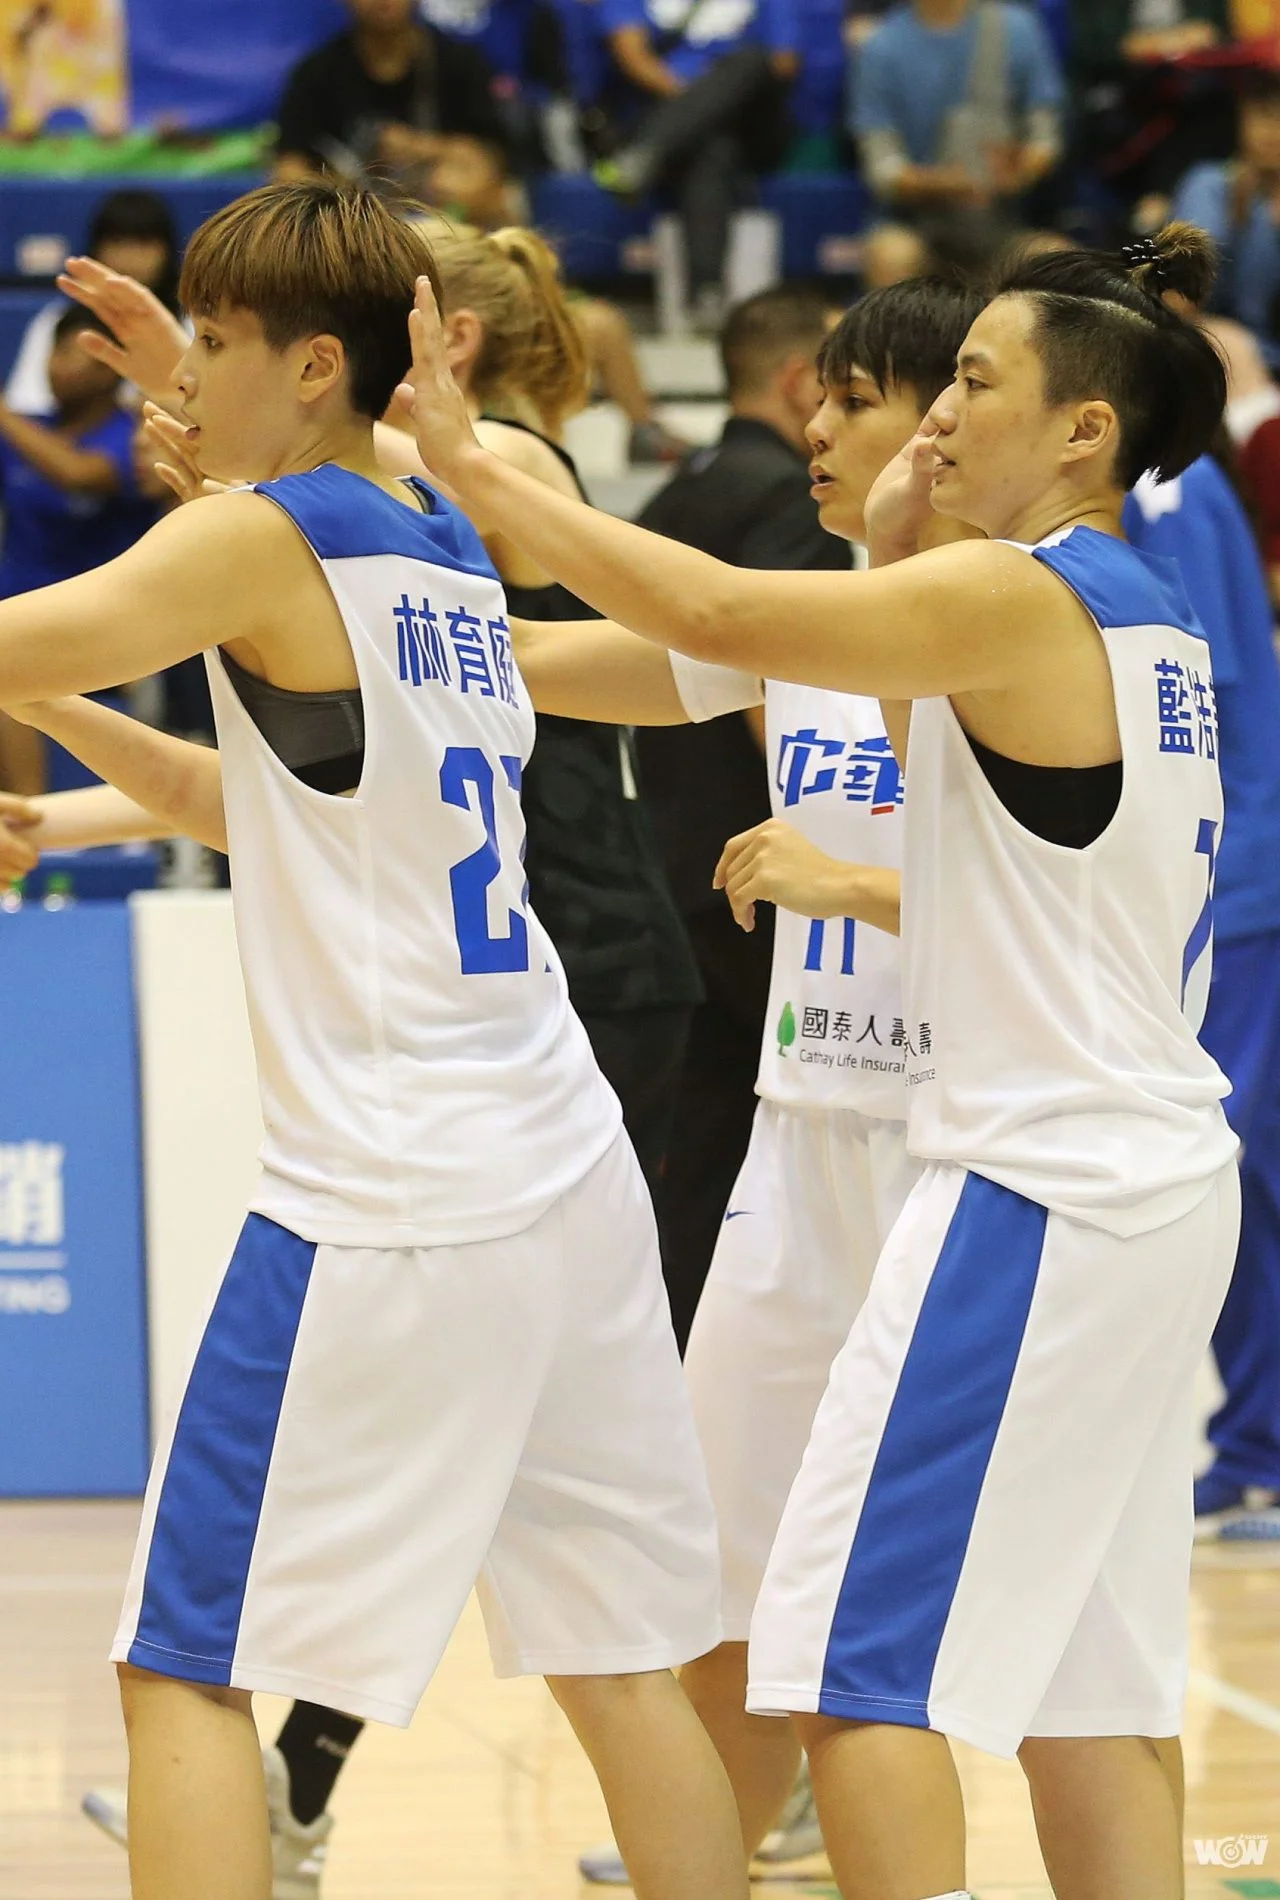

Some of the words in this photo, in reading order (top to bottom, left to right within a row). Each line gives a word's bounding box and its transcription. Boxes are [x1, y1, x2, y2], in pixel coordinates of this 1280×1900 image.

[1153, 658, 1219, 761] 藍浩
[776, 728, 905, 816] 中華
[799, 1048, 834, 1069] Cathay
[837, 1054, 858, 1068] Life
